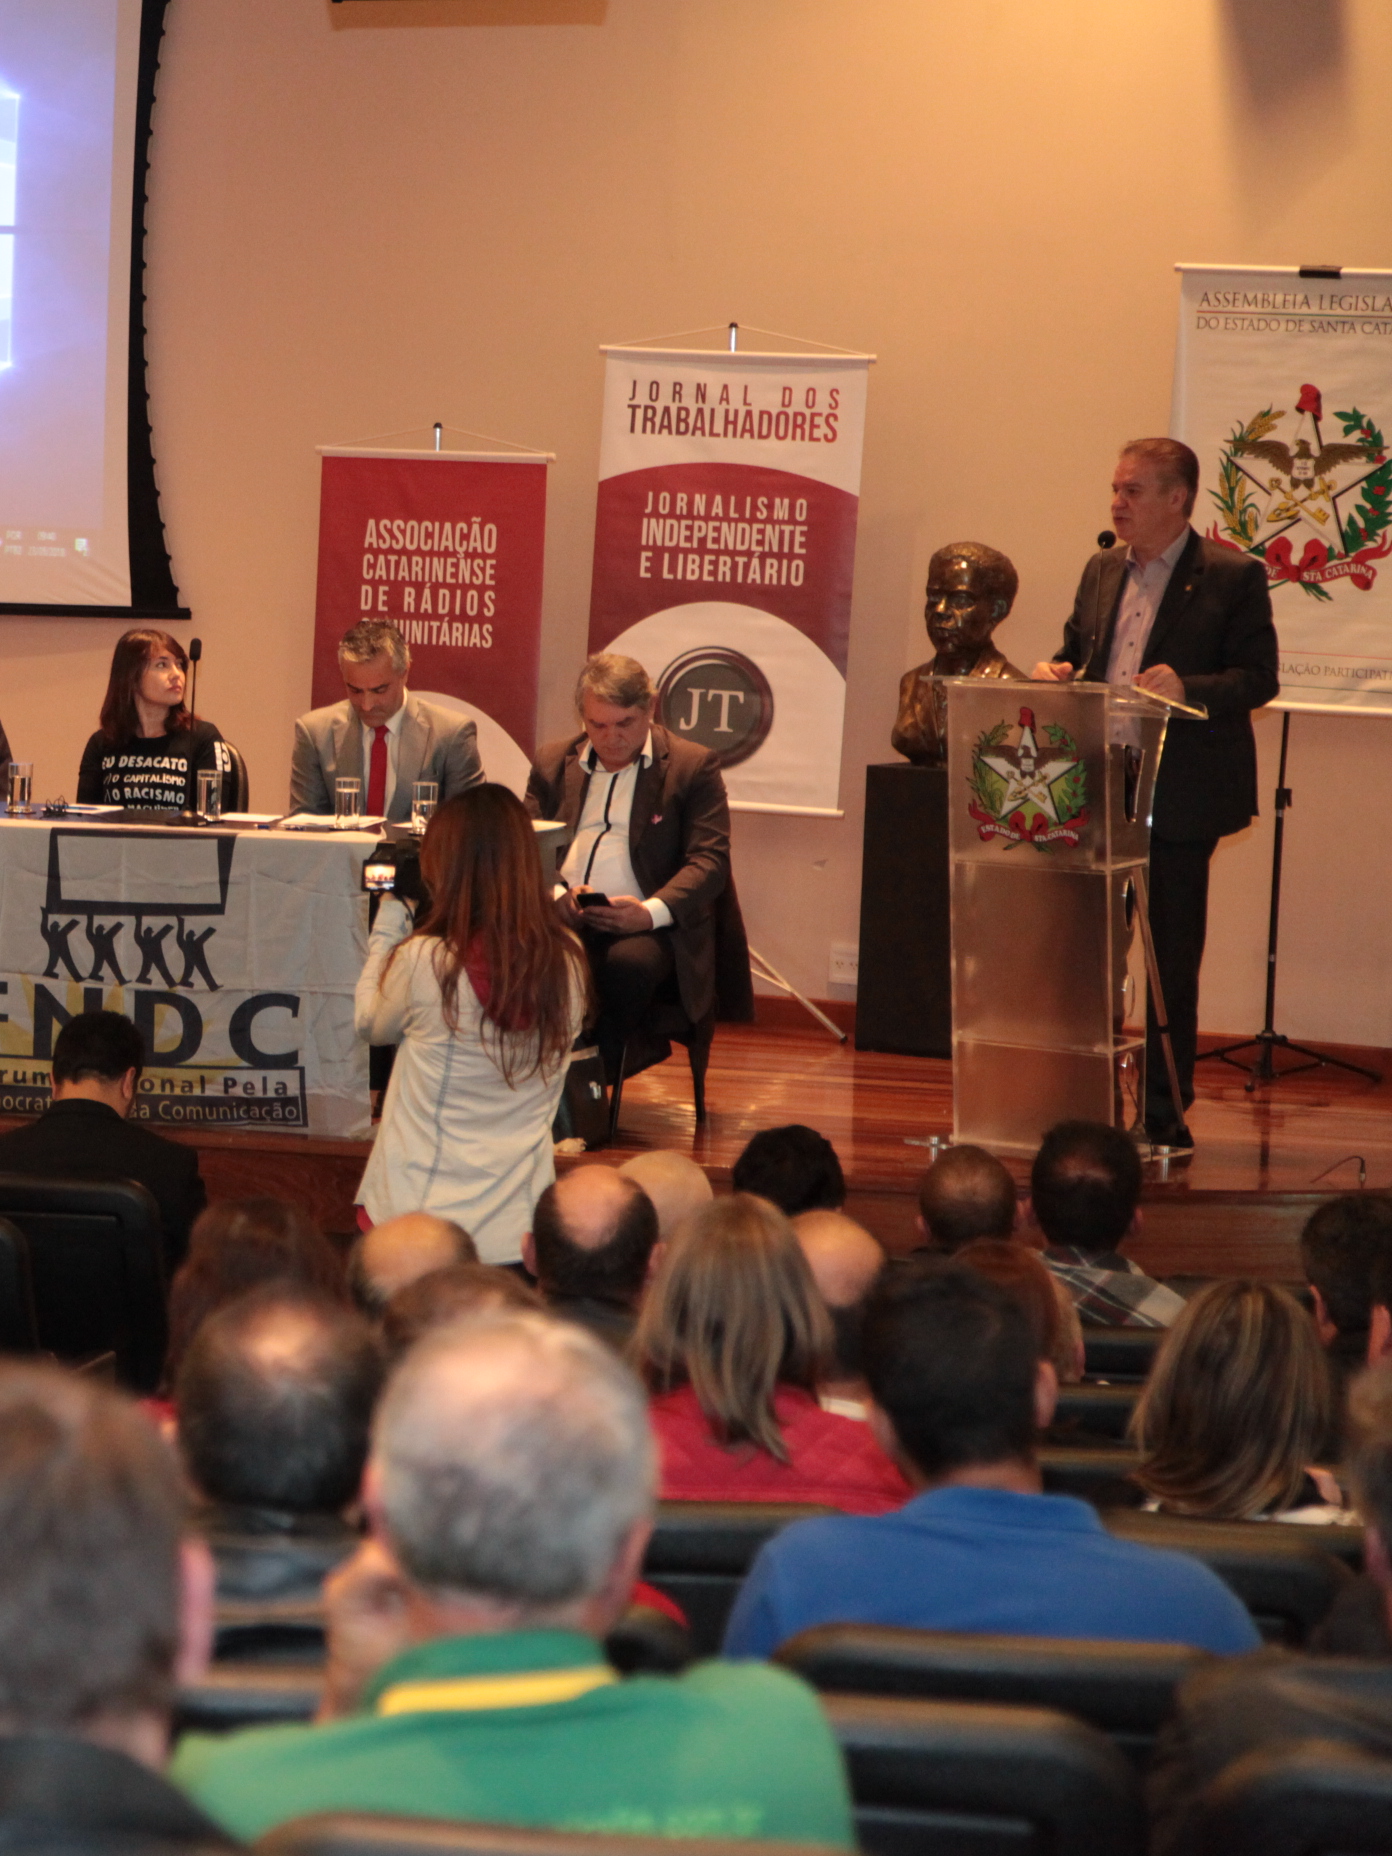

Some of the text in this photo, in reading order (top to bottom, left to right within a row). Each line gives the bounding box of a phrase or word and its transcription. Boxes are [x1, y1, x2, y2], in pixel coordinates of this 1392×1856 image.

[1199, 291, 1312, 311] ASSEMBLEIA
[1196, 316, 1219, 330] DO
[1224, 318, 1280, 332] ESTADO
[1285, 319, 1304, 333] DE
[1309, 319, 1357, 334] SANTA
[629, 379, 840, 411] JORNAL DOS
[627, 404, 839, 443] TRABALHADORES
[645, 491, 807, 521] JORNALISMO
[364, 517, 497, 558] ASSOCIAÇÃO
[641, 518, 807, 553] INDEPENDENTE
[362, 554, 496, 585] CATARINENSE
[640, 552, 804, 586] E LIBERTÁRIO
[1303, 571, 1322, 581] STA
[1325, 563, 1372, 579] CATARINA
[361, 583, 495, 617] DE RÁDIOS
[362, 617, 493, 648] UNITÁRIAS
[679, 688, 744, 732] JT
[118, 755, 188, 772] DESACATO
[124, 787, 185, 805] RACISMO
[140, 1067, 206, 1094] onal
[223, 1075, 288, 1096] Pela
[158, 1100, 297, 1123] Comunicação
